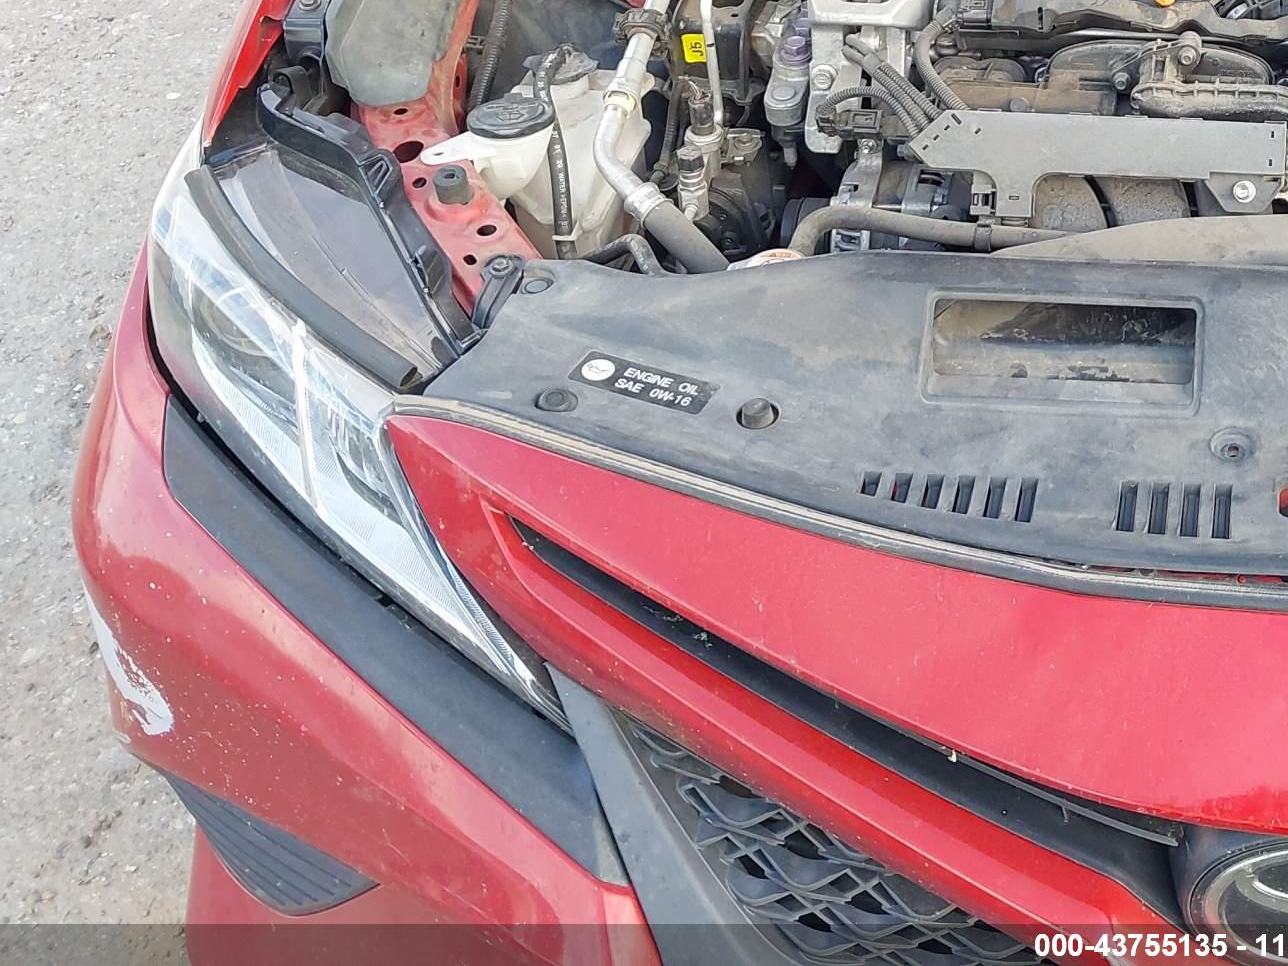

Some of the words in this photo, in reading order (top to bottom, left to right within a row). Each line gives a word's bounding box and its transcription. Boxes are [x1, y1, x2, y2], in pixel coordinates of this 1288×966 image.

[691, 41, 704, 57] J5
[558, 173, 567, 194] WATER
[614, 378, 645, 394] SAE
[649, 388, 693, 407] 0W-16
[623, 367, 674, 388] ENGINE
[678, 383, 700, 396] OIL
